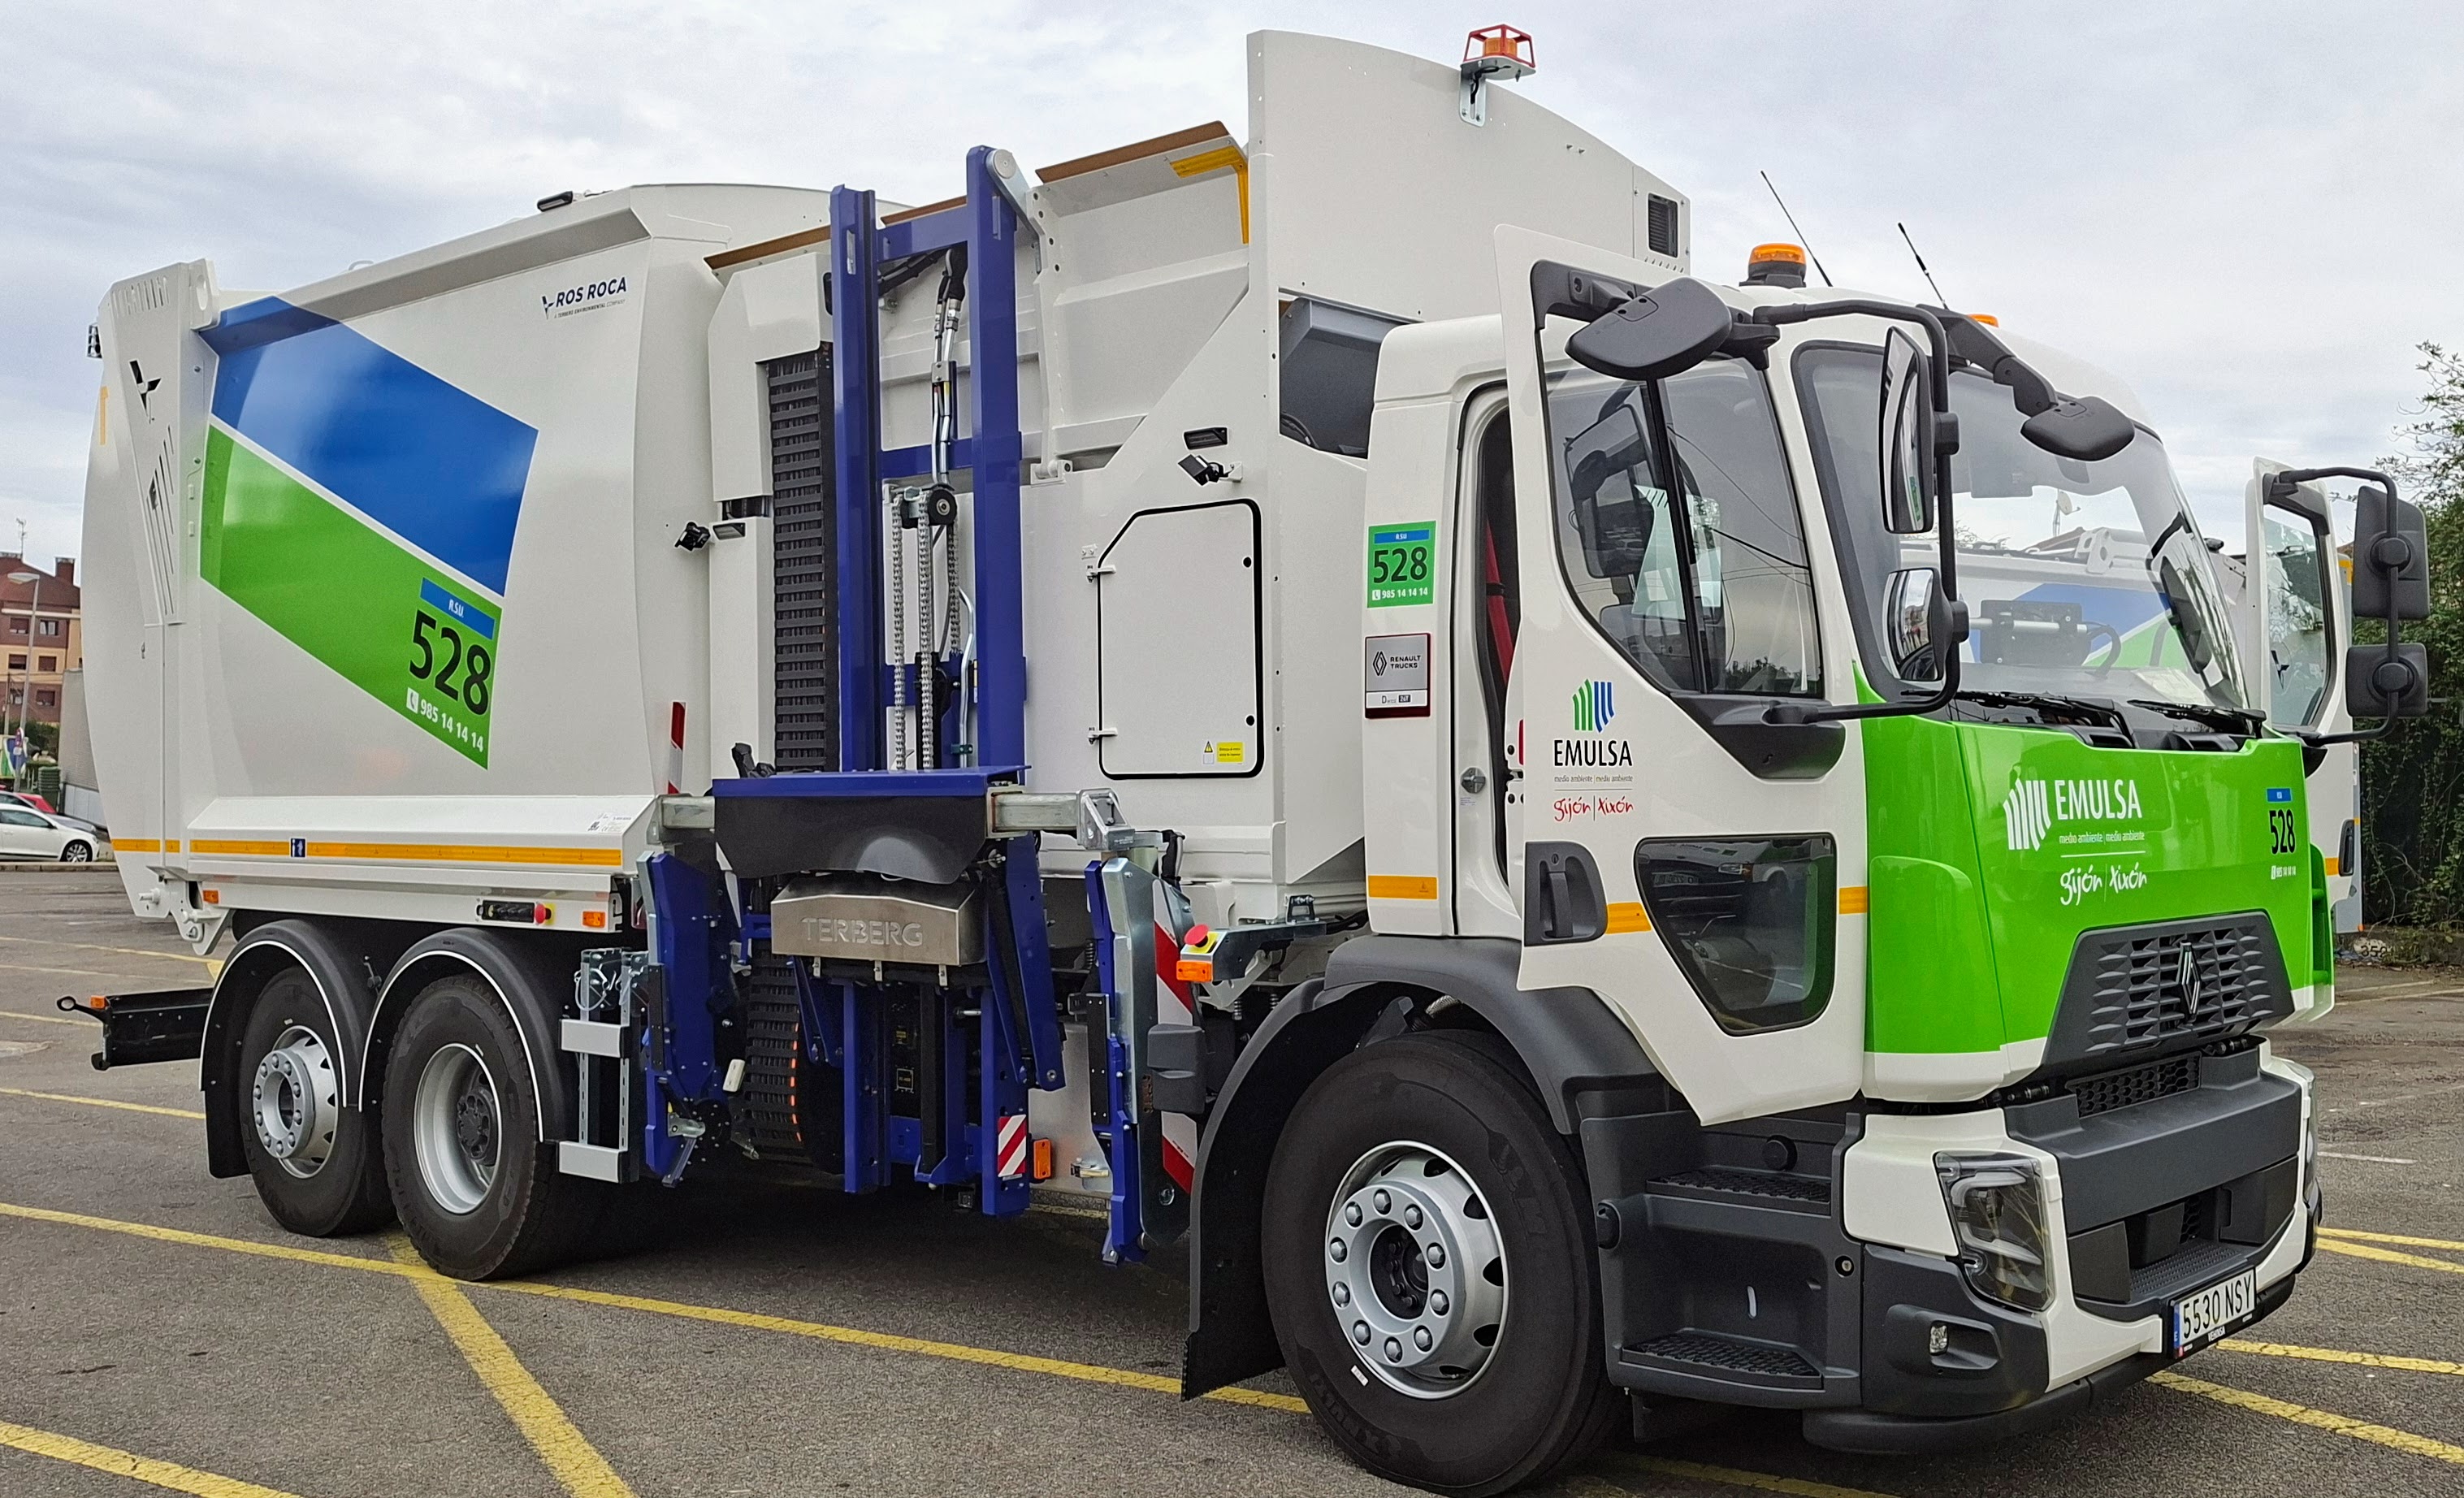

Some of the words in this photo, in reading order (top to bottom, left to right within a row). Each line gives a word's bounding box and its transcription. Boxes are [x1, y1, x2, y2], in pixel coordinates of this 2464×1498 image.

[555, 287, 583, 308] ROS
[587, 276, 627, 301] ROCA
[1373, 546, 1427, 584] 528
[1382, 589, 1395, 599] 985
[1397, 588, 1406, 598] 14
[1408, 587, 1417, 597] 14
[1419, 587, 1428, 596] 14
[409, 609, 492, 716] 528
[1390, 655, 1421, 663] RENAULT
[420, 699, 439, 724] 985
[441, 712, 453, 733] 14
[456, 722, 468, 743] 14
[471, 732, 483, 752] 14
[1554, 739, 1633, 766] EMULSA
[2055, 779, 2142, 820] EMULSA
[2269, 809, 2296, 855] 528
[800, 917, 924, 947] TERBERG
[2183, 1290, 2220, 1339] 5530
[2225, 1275, 2251, 1318] NSY
